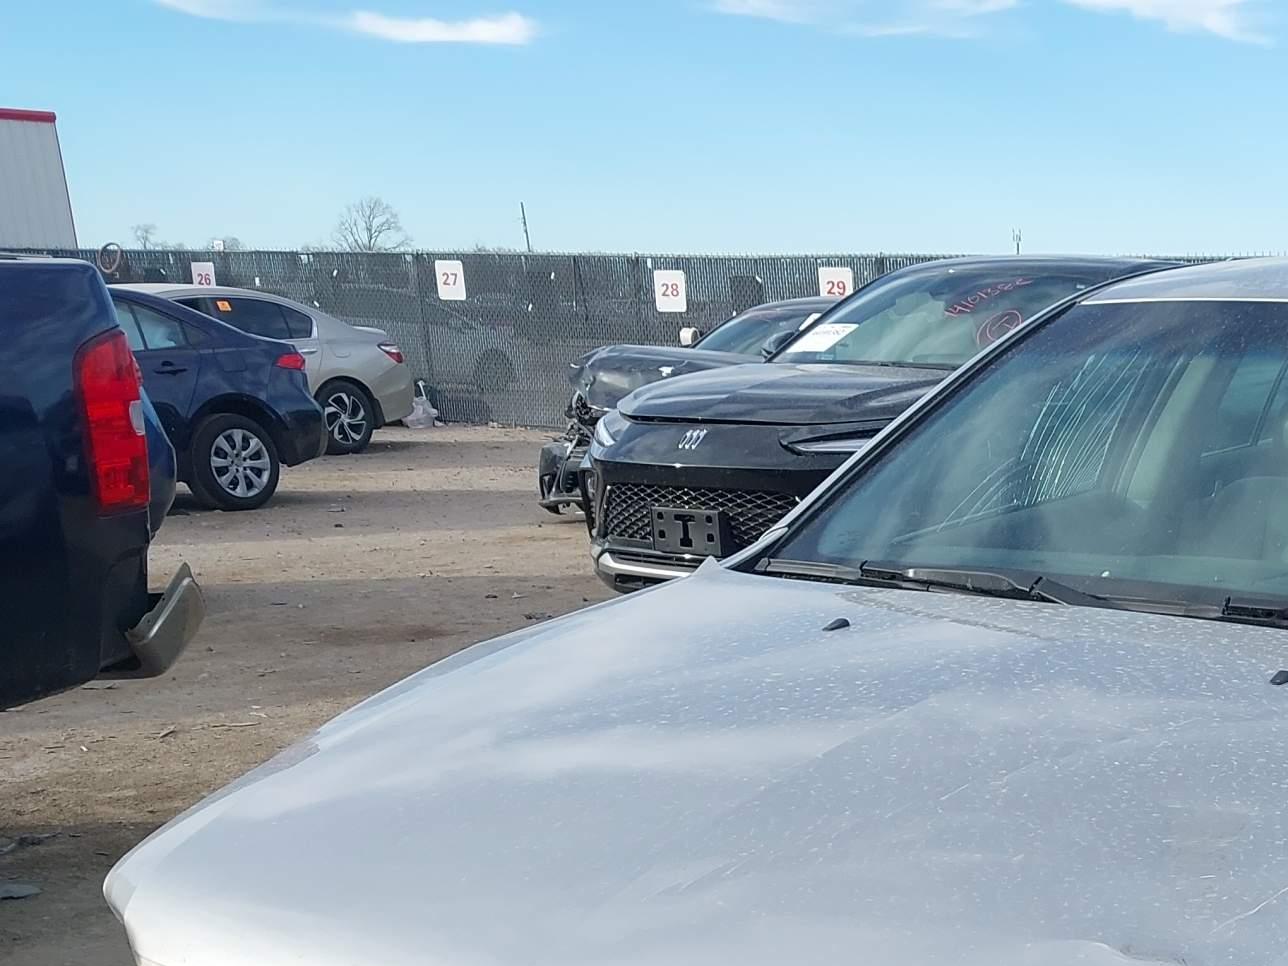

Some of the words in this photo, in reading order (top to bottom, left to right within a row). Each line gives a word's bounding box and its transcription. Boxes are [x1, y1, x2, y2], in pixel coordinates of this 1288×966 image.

[197, 273, 211, 286] 26
[441, 272, 458, 286] 27
[661, 283, 679, 297] 28
[826, 280, 847, 296] 29
